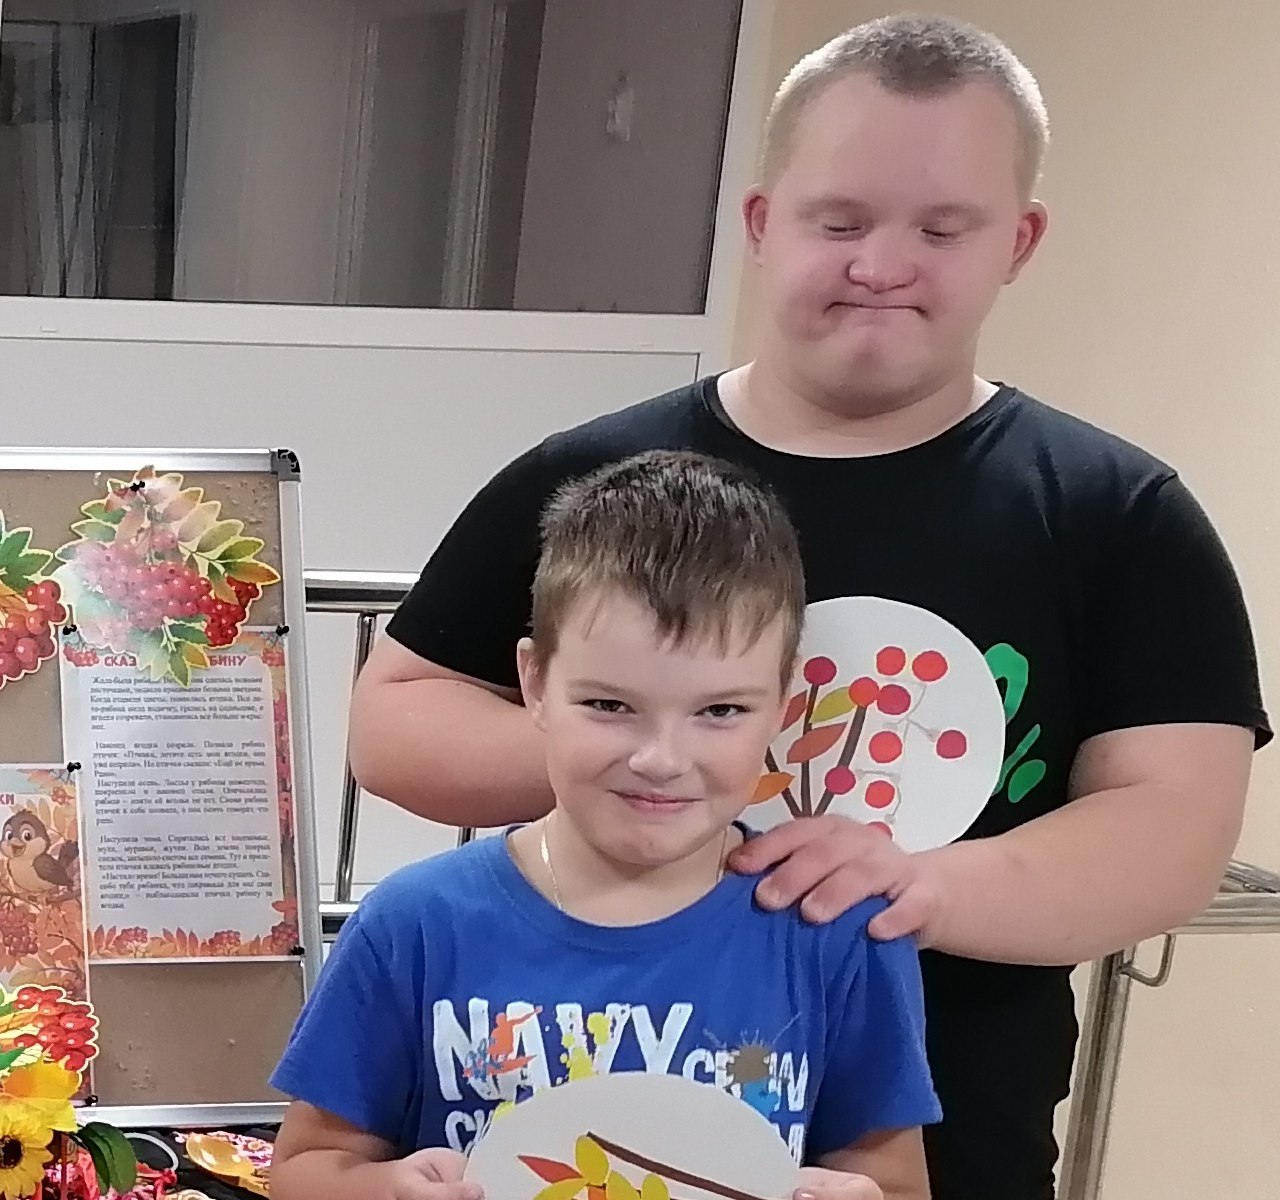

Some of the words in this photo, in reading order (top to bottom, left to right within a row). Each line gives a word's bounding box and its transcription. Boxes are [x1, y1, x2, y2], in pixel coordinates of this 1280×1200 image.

[104, 656, 137, 667] СКАЗ
[210, 656, 247, 667] БИНУ
[433, 998, 693, 1104] NAVY
[682, 1048, 809, 1111] CRW
